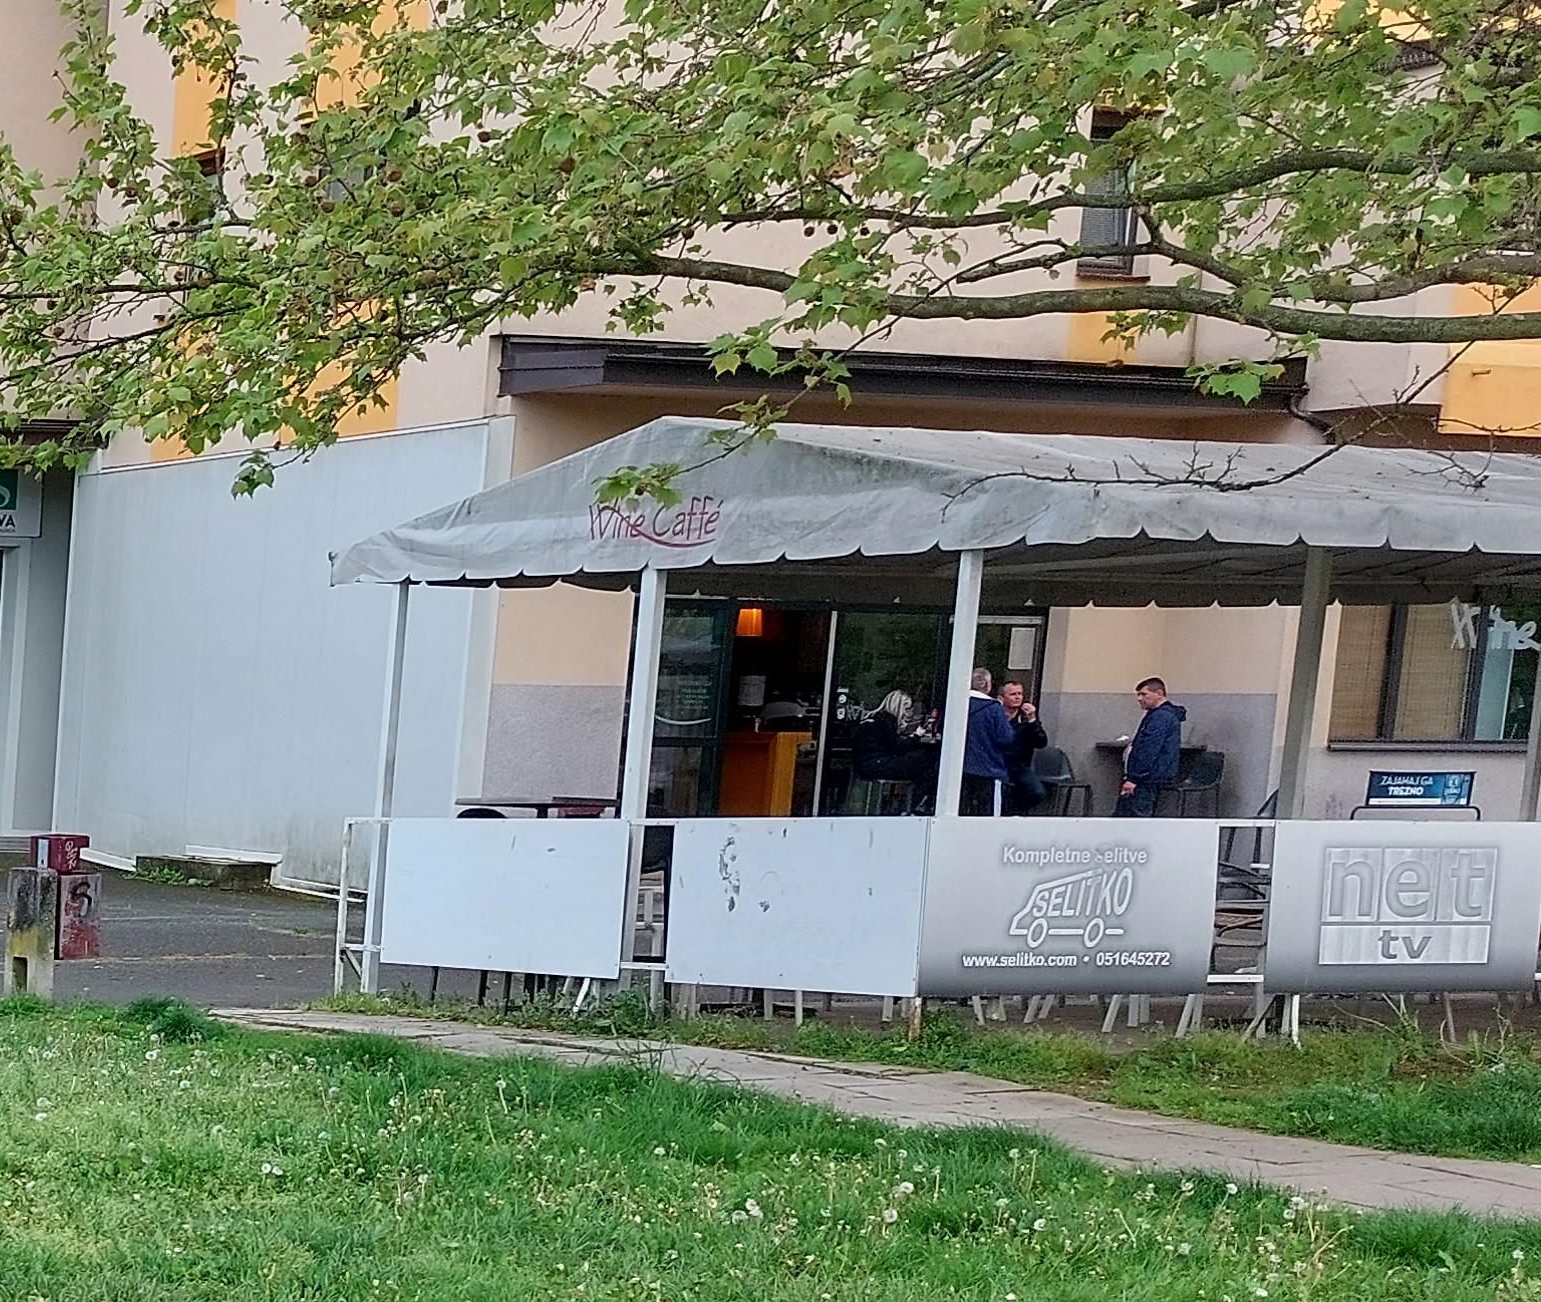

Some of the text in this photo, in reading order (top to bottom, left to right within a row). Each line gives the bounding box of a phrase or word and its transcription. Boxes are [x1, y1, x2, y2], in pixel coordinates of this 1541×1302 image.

[1420, 776, 1434, 786] GA
[1002, 846, 1091, 867] Kompletne
[1032, 867, 1134, 918] SELITKO
[1328, 853, 1486, 918] net
[1378, 929, 1433, 960] tv
[962, 951, 1171, 967] www.selitko.com 051645272
